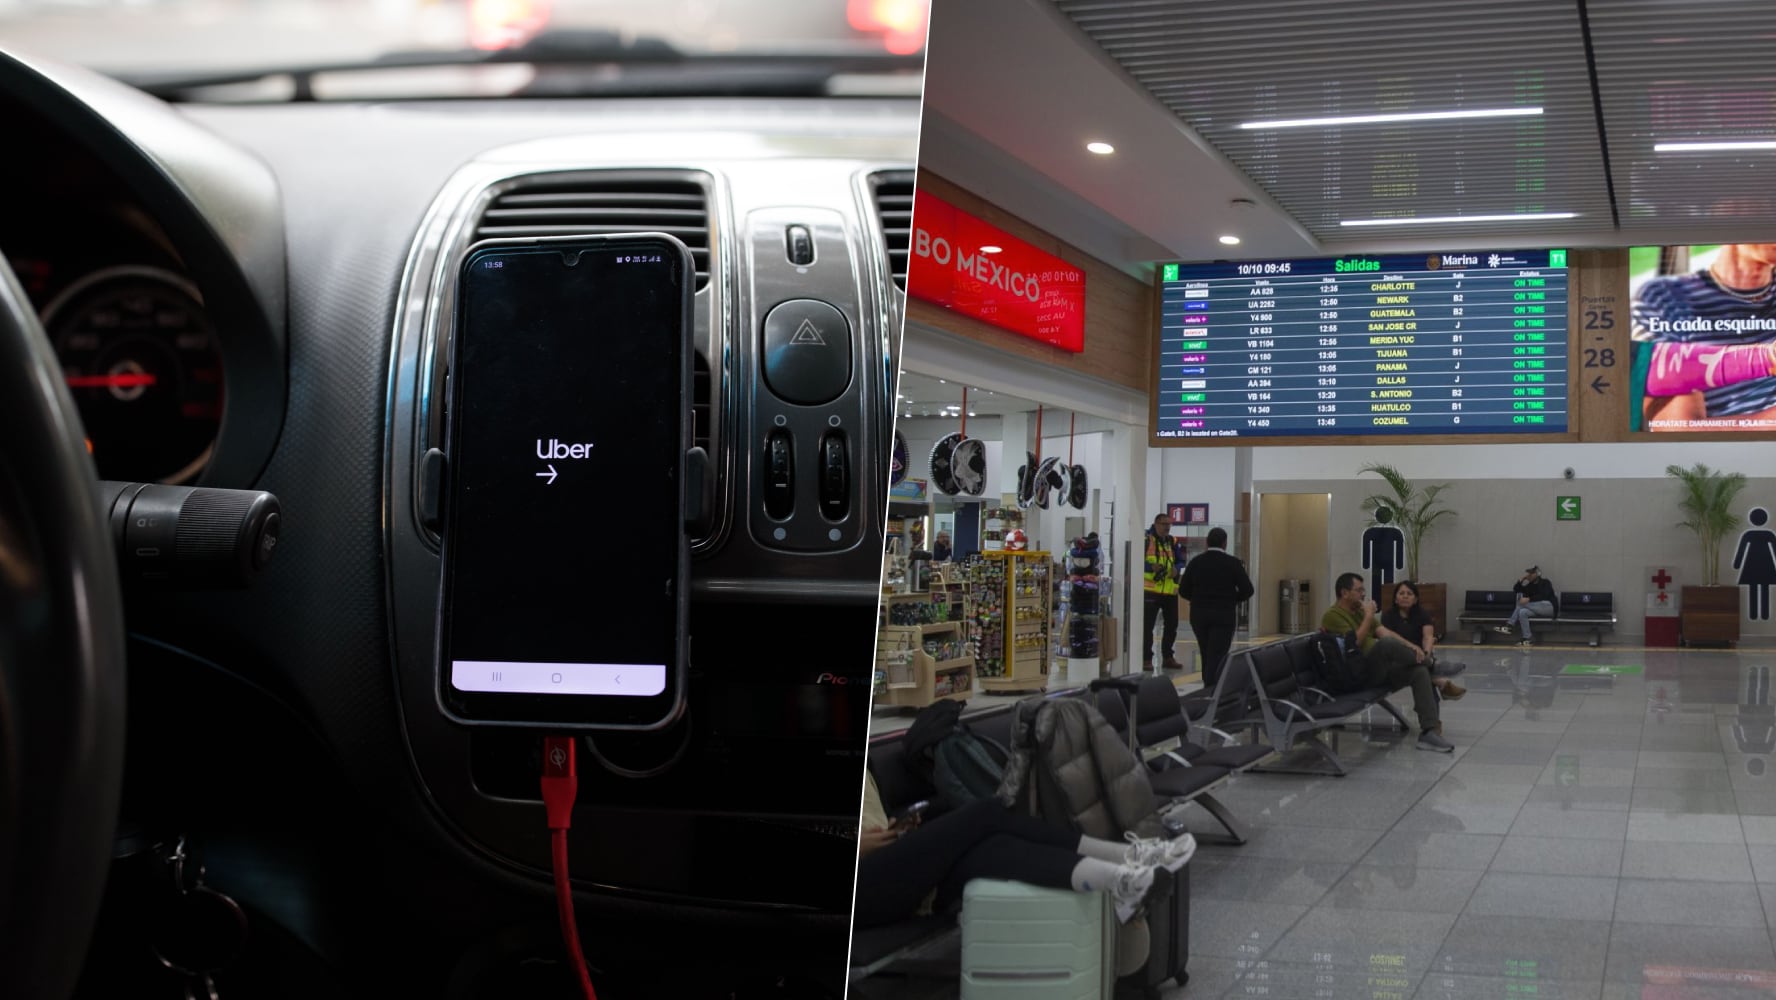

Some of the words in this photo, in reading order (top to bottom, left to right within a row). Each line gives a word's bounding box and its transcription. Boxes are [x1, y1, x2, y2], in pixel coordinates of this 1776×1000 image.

[1238, 264, 1263, 274] 10/10
[1264, 263, 1291, 273] 09:45
[1335, 259, 1380, 273] Salidas
[1442, 255, 1478, 266] Marina
[957, 246, 1039, 302] MÉXICO
[1371, 283, 1415, 291] CHARLOTTE
[1370, 309, 1415, 318] GUATEMALA
[1585, 311, 1614, 329] 25
[1649, 317, 1670, 332] En
[1673, 316, 1711, 331] cada
[1715, 315, 1776, 333] esquina
[1584, 349, 1615, 368] 28
[536, 439, 593, 459] Uber
